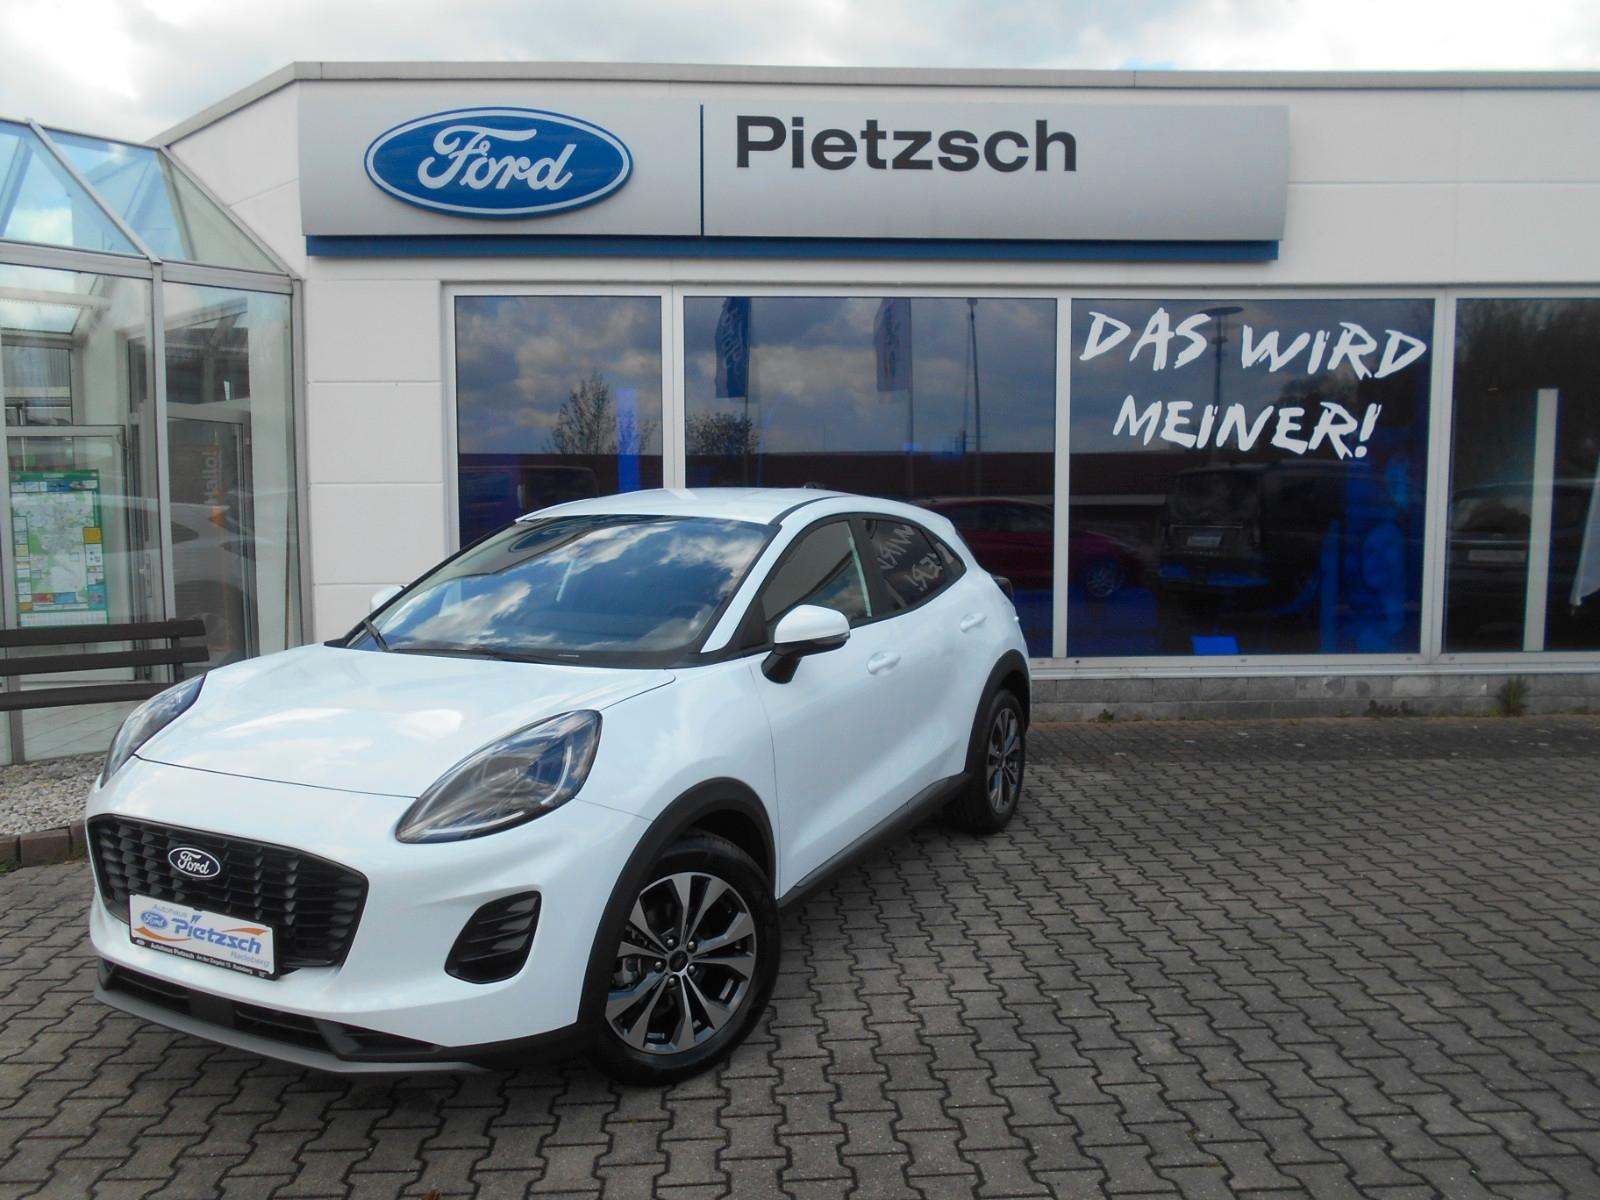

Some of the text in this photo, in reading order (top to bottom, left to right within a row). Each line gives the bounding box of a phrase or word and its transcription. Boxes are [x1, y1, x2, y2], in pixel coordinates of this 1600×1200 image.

[418, 114, 1078, 192] Ford Pietzsch
[1079, 307, 1427, 380] DAS WIRD
[1112, 395, 1382, 460] MEINER!
[177, 850, 210, 875] Ford
[171, 914, 262, 955] Pietzsch
